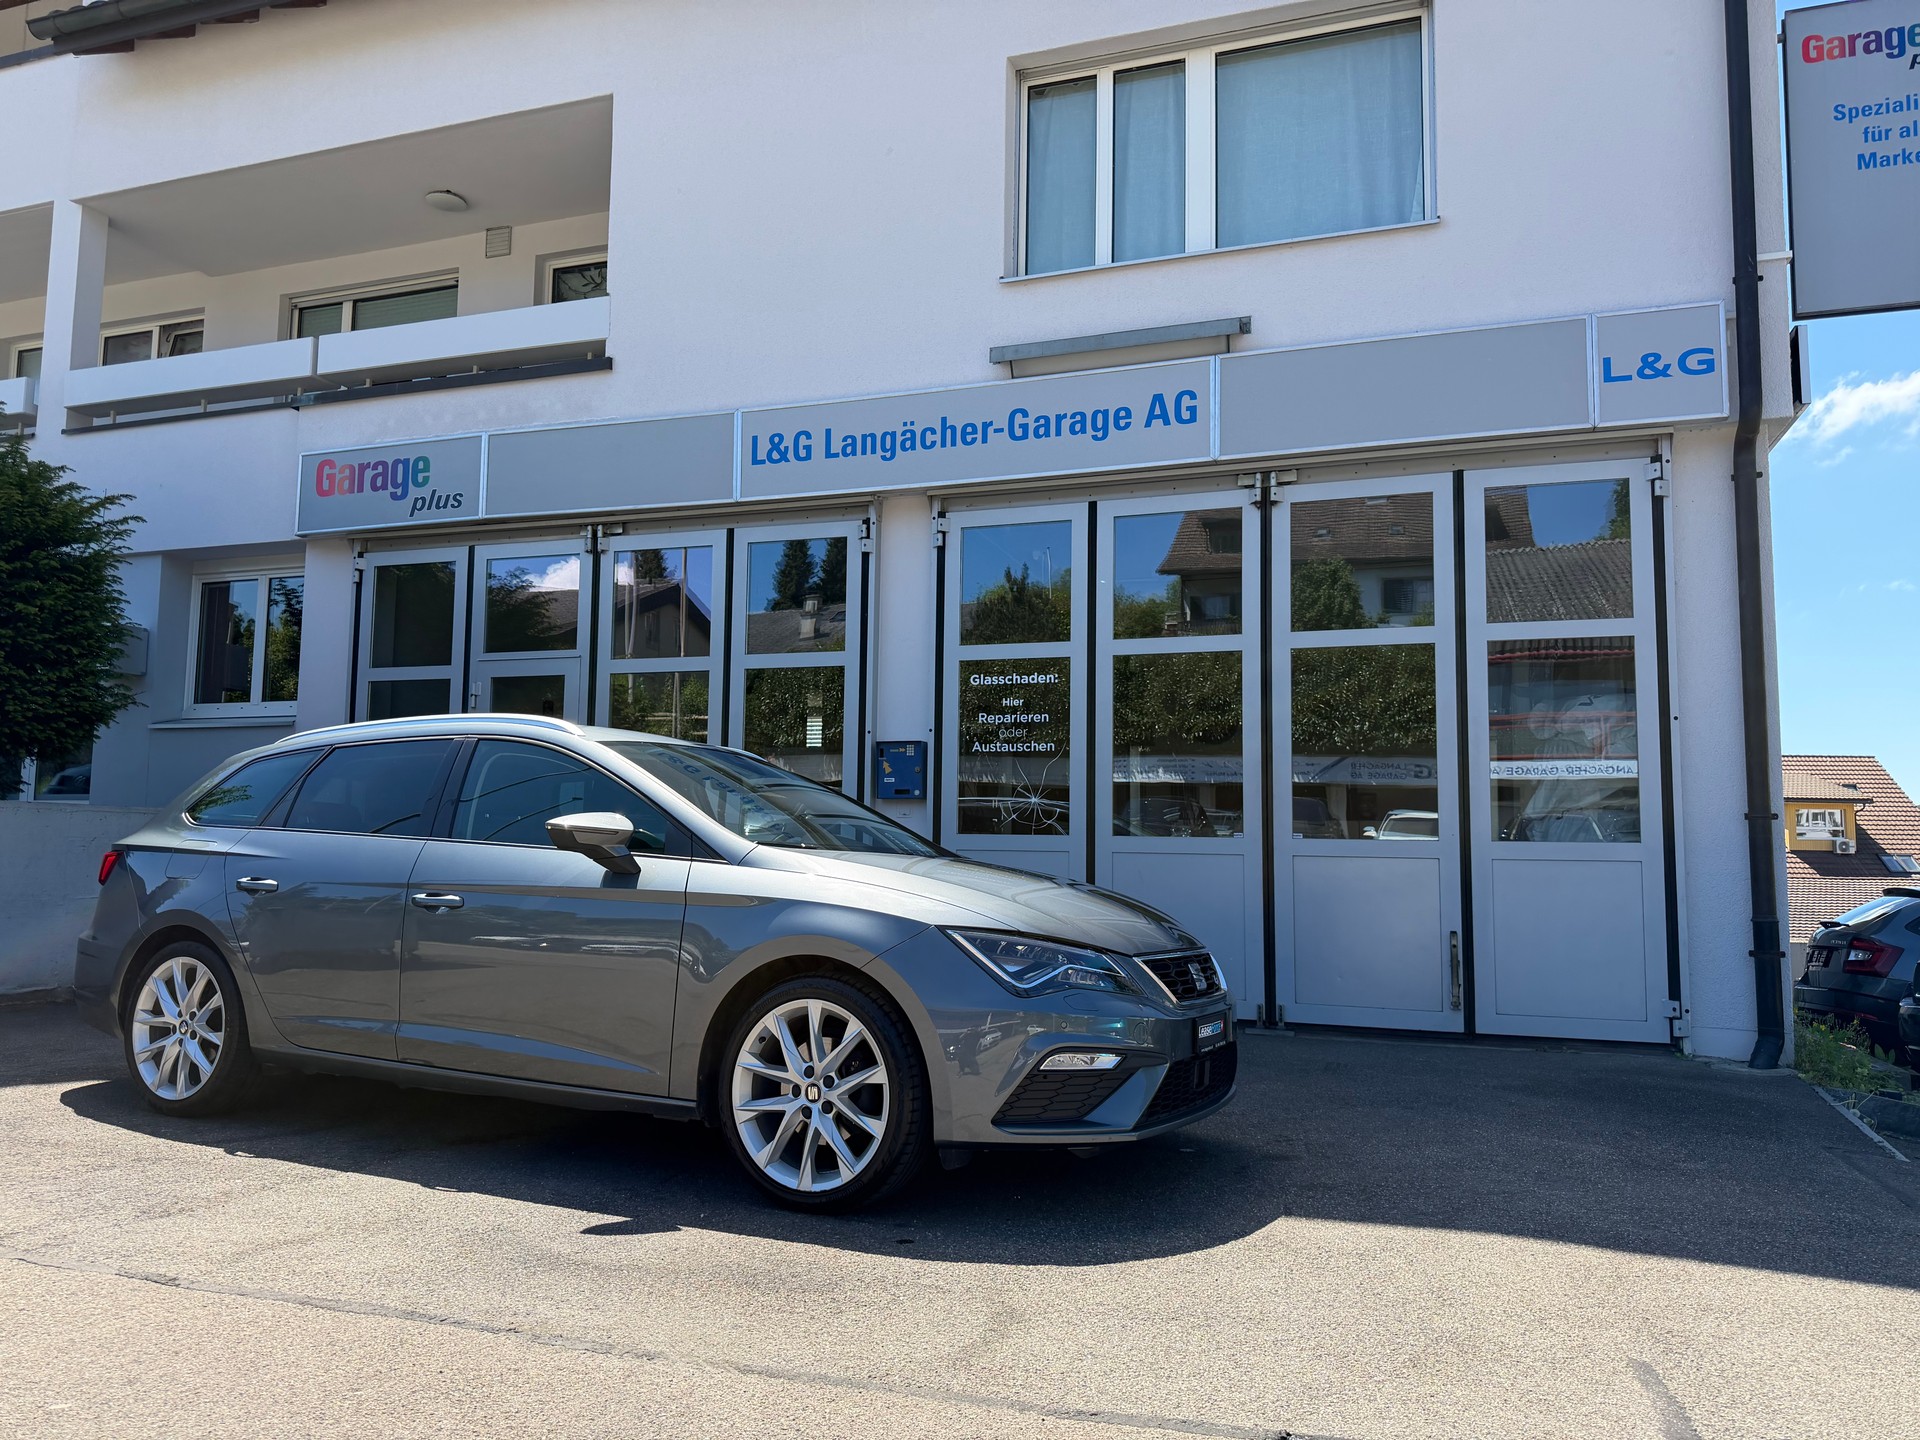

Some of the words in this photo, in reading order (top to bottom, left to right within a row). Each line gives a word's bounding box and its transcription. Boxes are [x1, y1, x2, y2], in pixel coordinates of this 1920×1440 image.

[1802, 23, 1920, 64] Garage
[1862, 126, 1892, 143] für
[1603, 347, 1715, 383] L&G
[750, 430, 812, 466] L&G
[825, 406, 1132, 462] Langächer-Garage
[1144, 390, 1198, 429] AG
[315, 455, 431, 501] Garage
[409, 488, 464, 518] plus
[970, 672, 1058, 685] Glasschaden:
[1002, 697, 1024, 707] Hier
[978, 711, 1049, 725] Reparieren
[998, 727, 1028, 737] oder
[972, 741, 1055, 753] Austauschen
